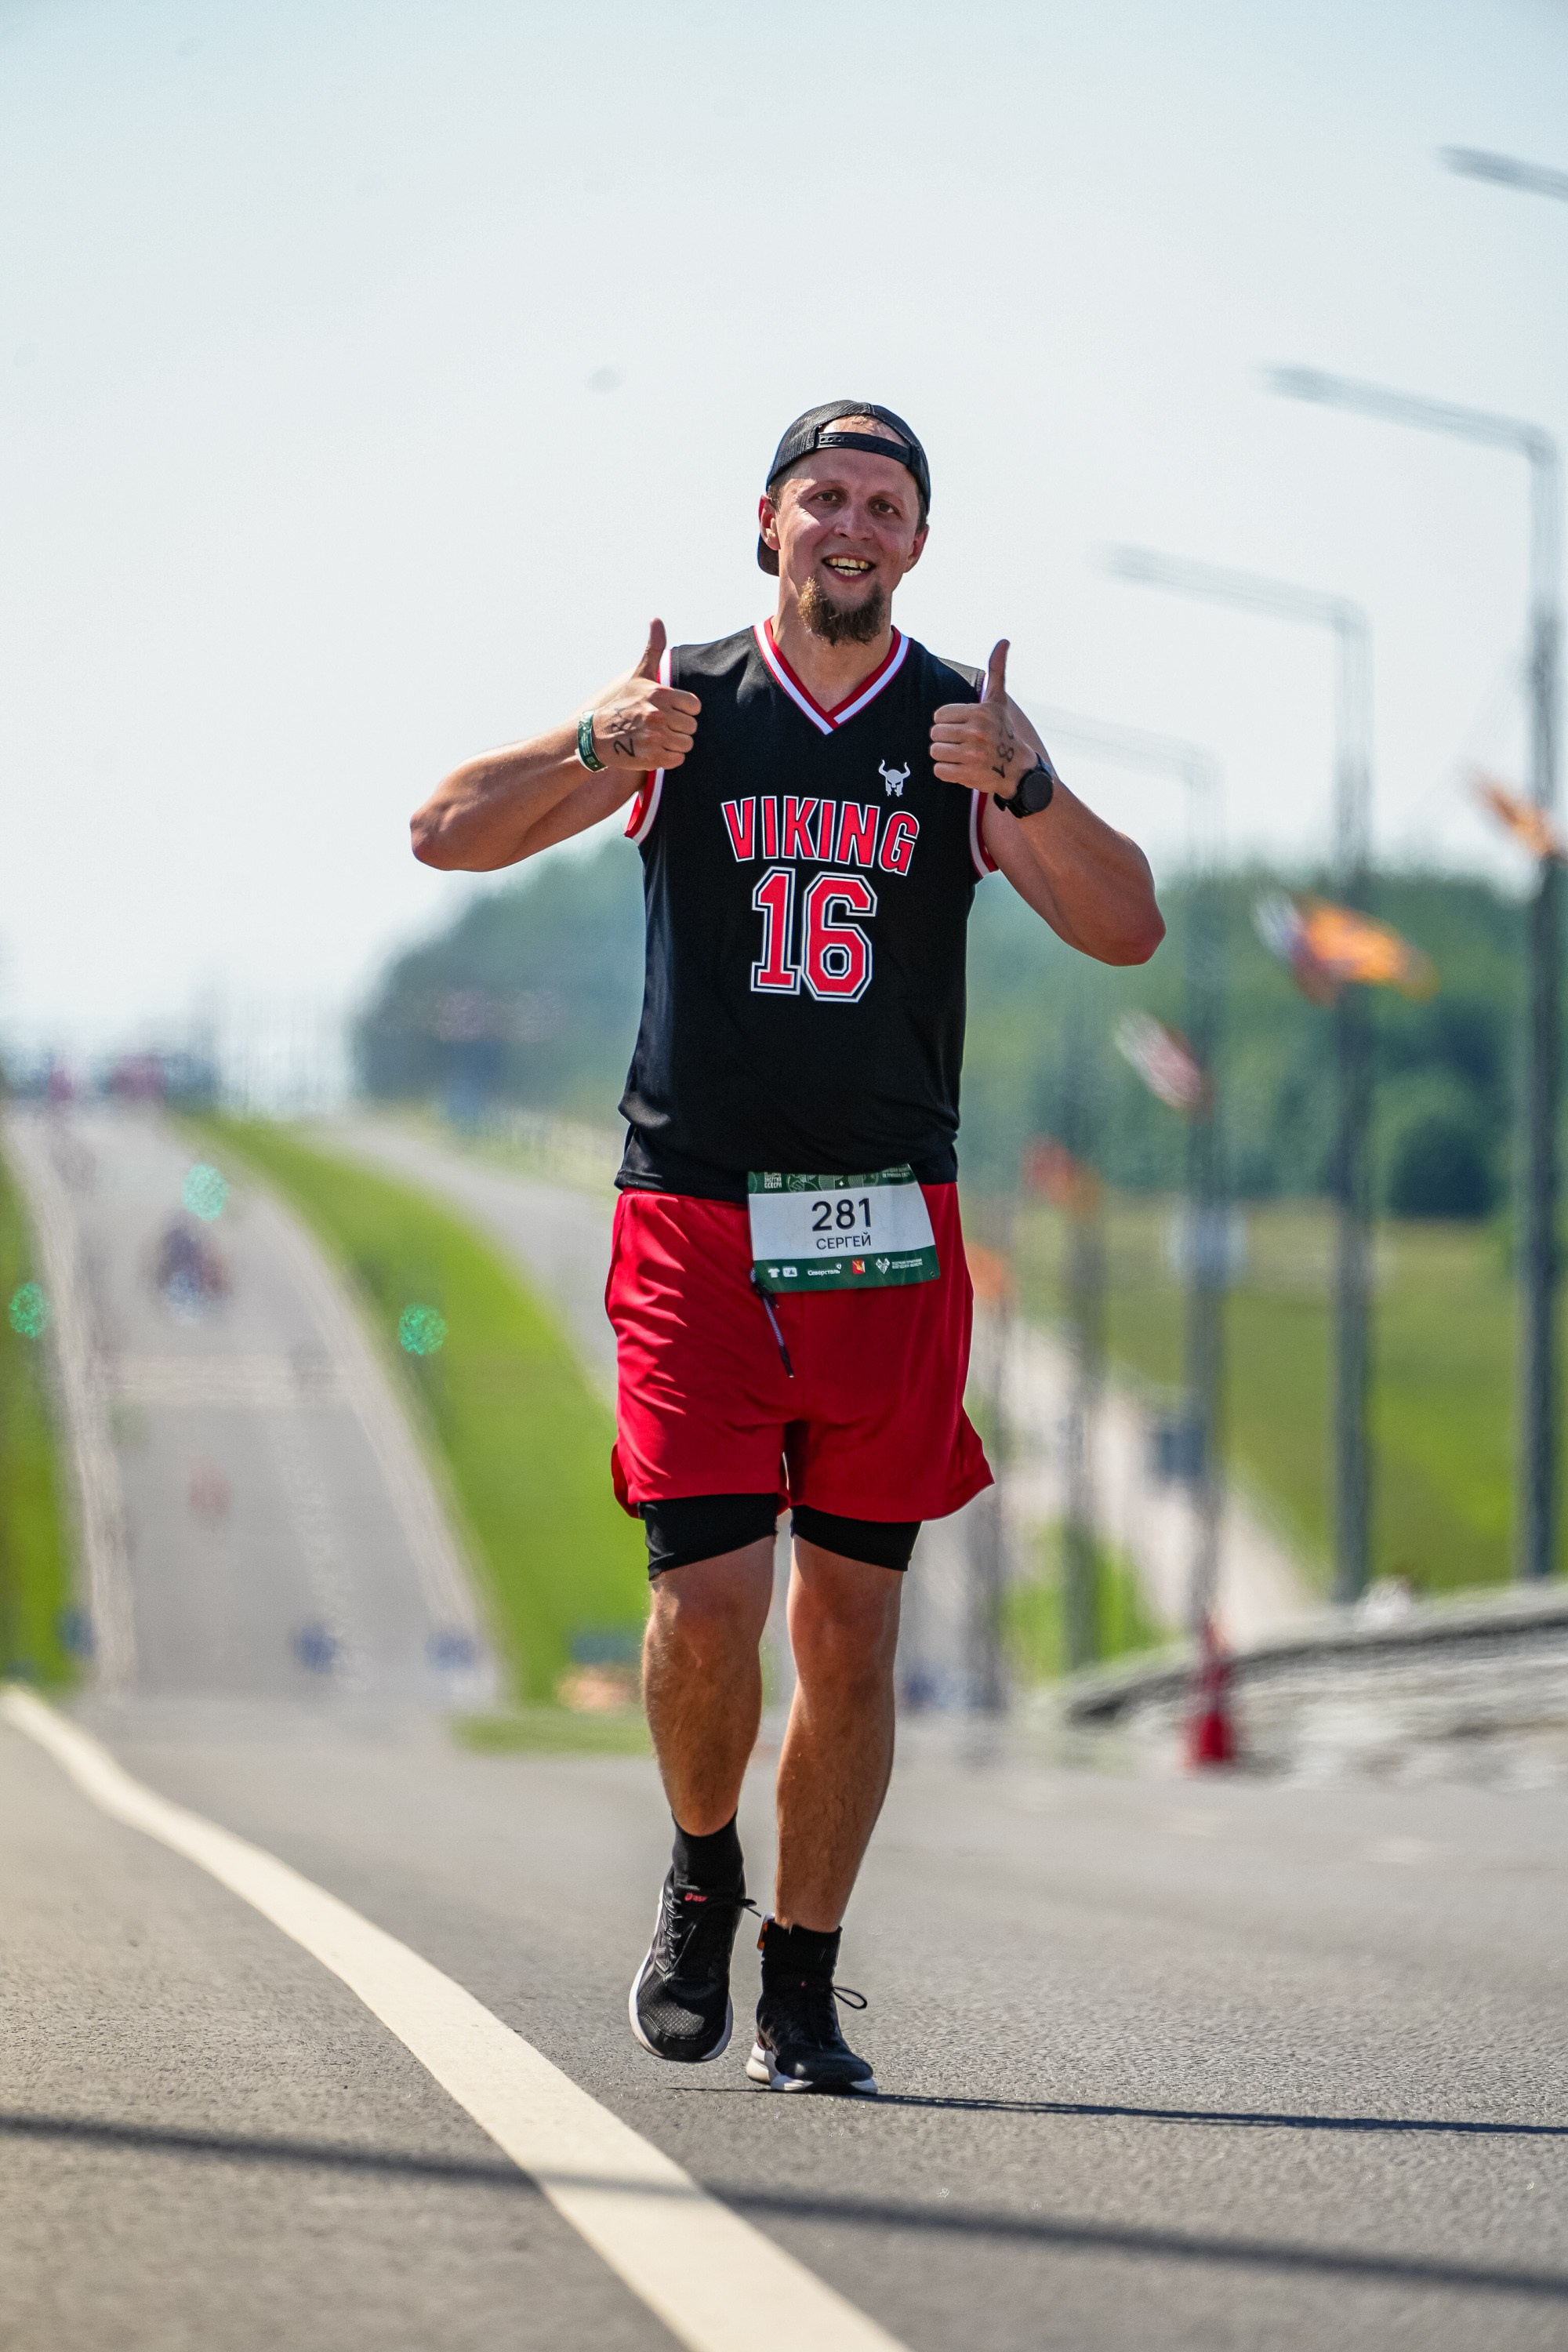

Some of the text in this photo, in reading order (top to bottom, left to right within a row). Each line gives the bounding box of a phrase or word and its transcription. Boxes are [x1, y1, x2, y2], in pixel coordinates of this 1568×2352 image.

[720, 796, 920, 876] VIKING
[750, 866, 877, 1003] 16
[811, 1198, 872, 1232] 281
[816, 1232, 872, 1250] СЕРГЕЙ
